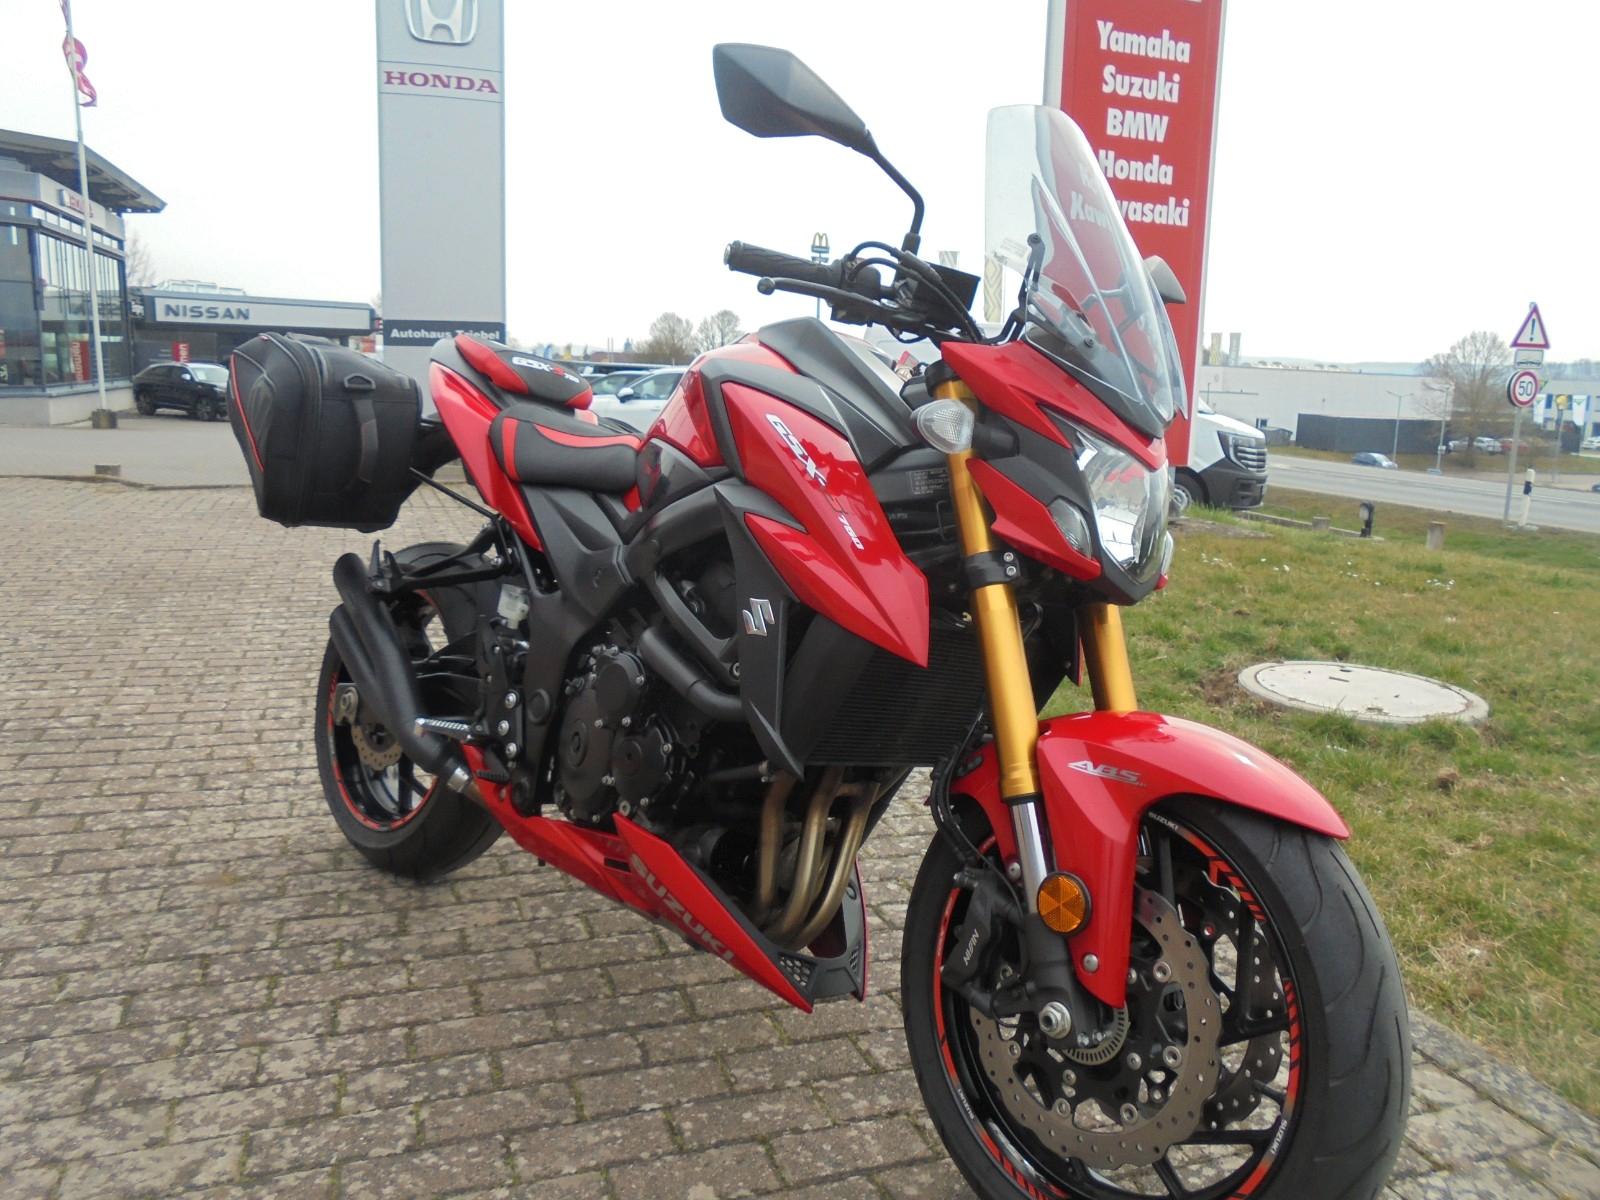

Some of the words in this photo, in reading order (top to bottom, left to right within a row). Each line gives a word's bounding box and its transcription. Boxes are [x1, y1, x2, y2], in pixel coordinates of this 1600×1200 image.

[1096, 20, 1191, 63] Yamaha
[383, 70, 499, 94] HONDA
[1102, 65, 1181, 103] Suzuki
[1106, 107, 1169, 143] BMW
[1099, 149, 1174, 185] Honda
[164, 304, 250, 320] NISSAN
[390, 328, 453, 339] Autohaus
[1518, 380, 1534, 397] 50
[1067, 759, 1142, 785] ABS
[629, 853, 735, 962] SUZUKI
